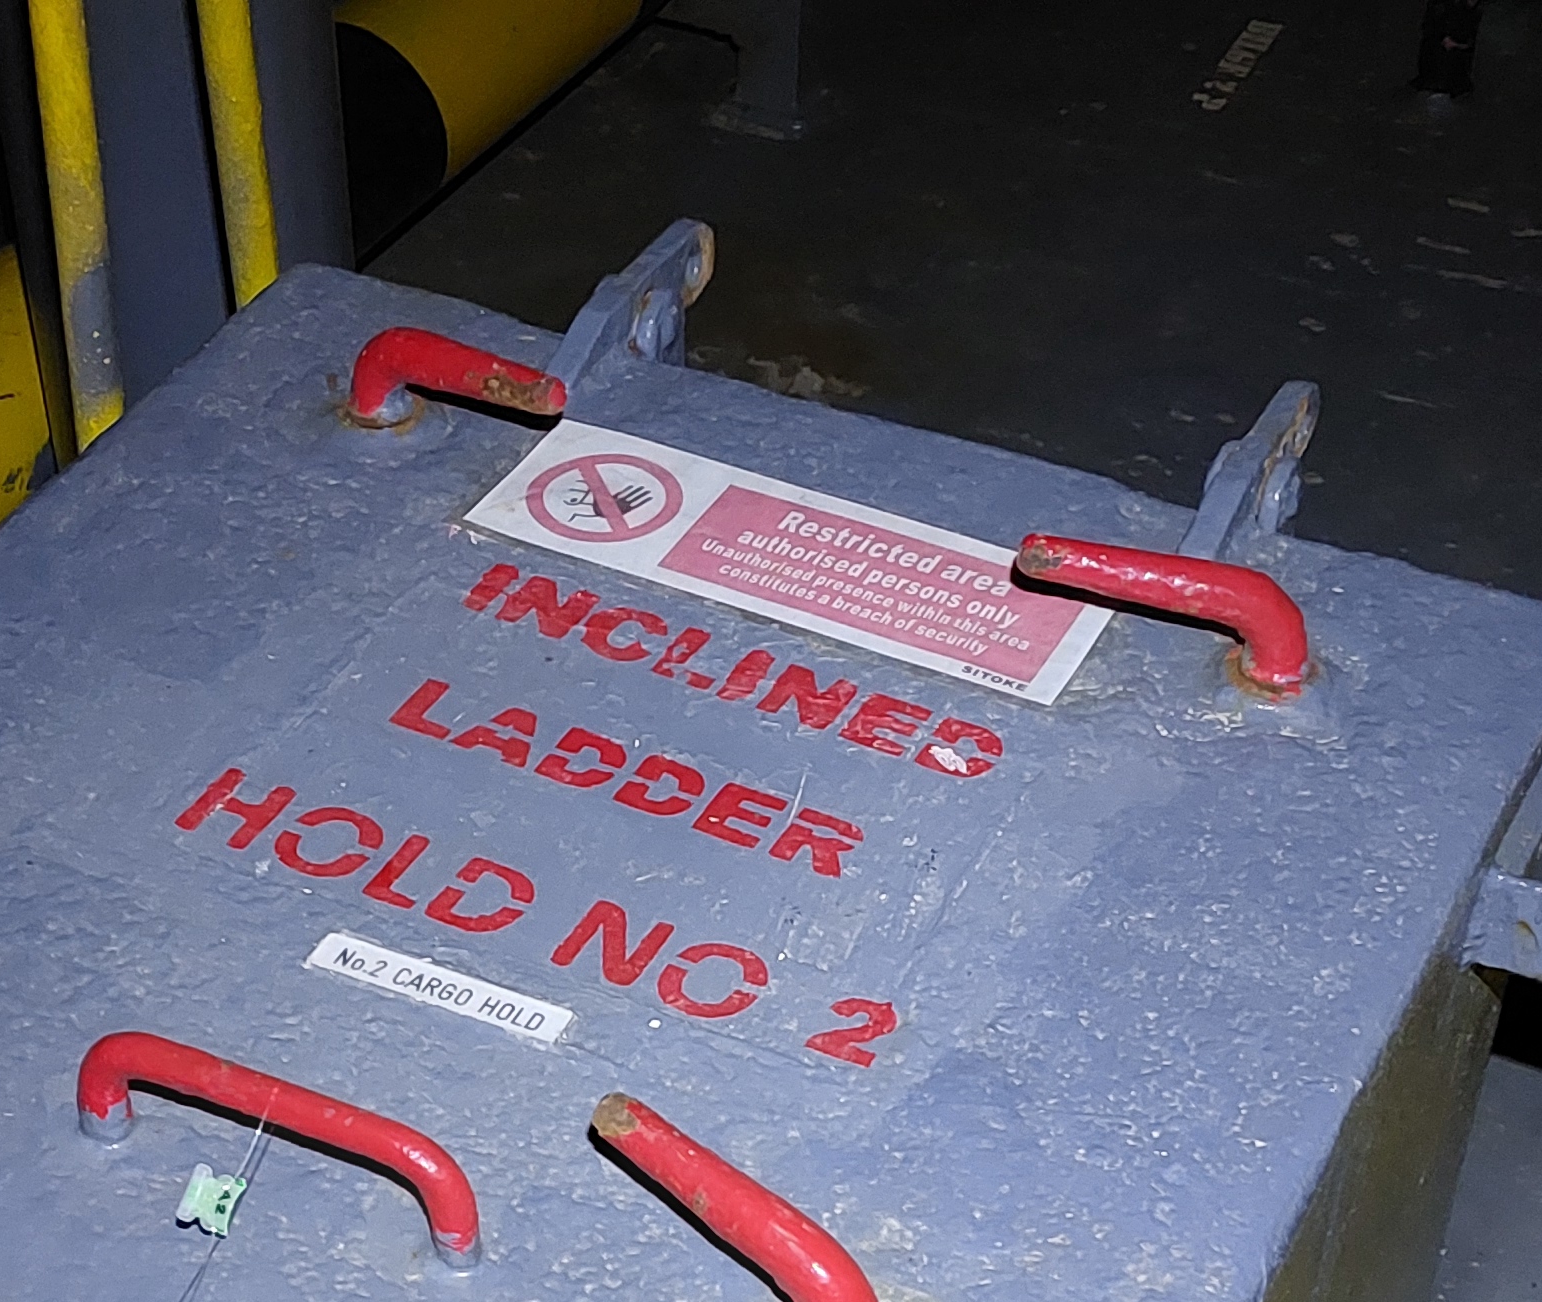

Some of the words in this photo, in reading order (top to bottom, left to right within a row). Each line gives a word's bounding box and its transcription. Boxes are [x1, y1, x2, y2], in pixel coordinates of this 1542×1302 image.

[701, 538, 817, 582] Unauthorised
[812, 575, 895, 608] presence
[896, 600, 952, 625] within
[953, 617, 987, 637] this
[988, 629, 1030, 651] area
[737, 530, 869, 578] authorised
[863, 568, 963, 608] persons
[966, 600, 1021, 629] only
[777, 510, 943, 575] Restricted
[940, 564, 1013, 598] area
[719, 564, 817, 601] constitutes
[817, 590, 831, 605] a
[831, 595, 895, 626] breach
[893, 617, 917, 632] of
[914, 624, 989, 657] security
[462, 563, 1004, 778] INCLINED
[961, 664, 1029, 693] SITOKE
[388, 678, 865, 879] LADDER
[174, 767, 536, 933] HOLD
[550, 900, 770, 1019] NO
[804, 997, 899, 1069] 2
[333, 948, 389, 978] No.2
[392, 968, 474, 1006] CARGO
[477, 996, 546, 1032] HOLD
